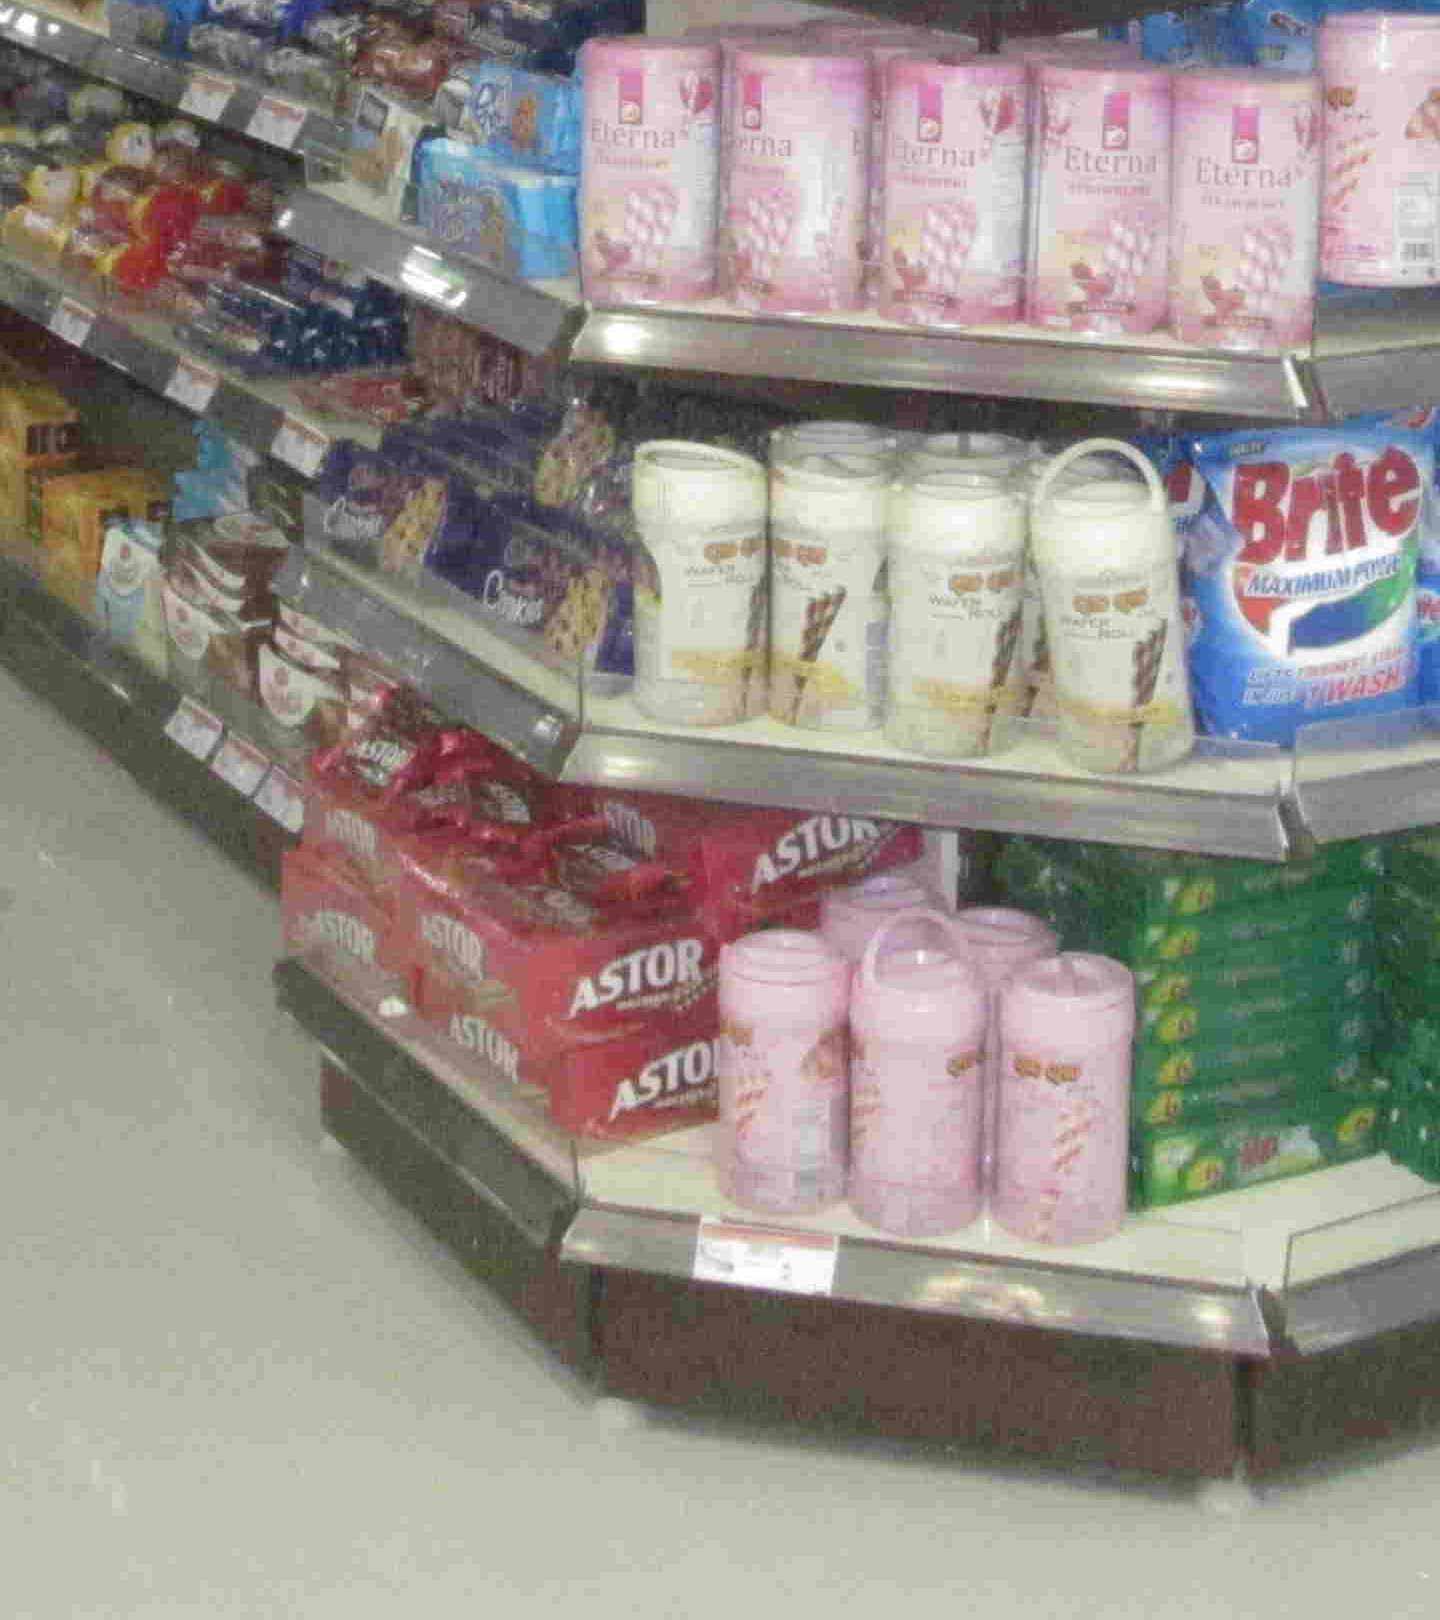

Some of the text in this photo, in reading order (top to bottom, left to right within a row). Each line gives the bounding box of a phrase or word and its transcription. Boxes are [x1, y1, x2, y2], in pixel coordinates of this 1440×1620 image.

[591, 118, 676, 150] Eterna
[1063, 145, 1159, 175] Eterna
[1195, 157, 1293, 189] Eterna
[1233, 446, 1421, 563] Brite
[568, 938, 704, 1021] ASTOR
[610, 1038, 720, 1122] ASTO
